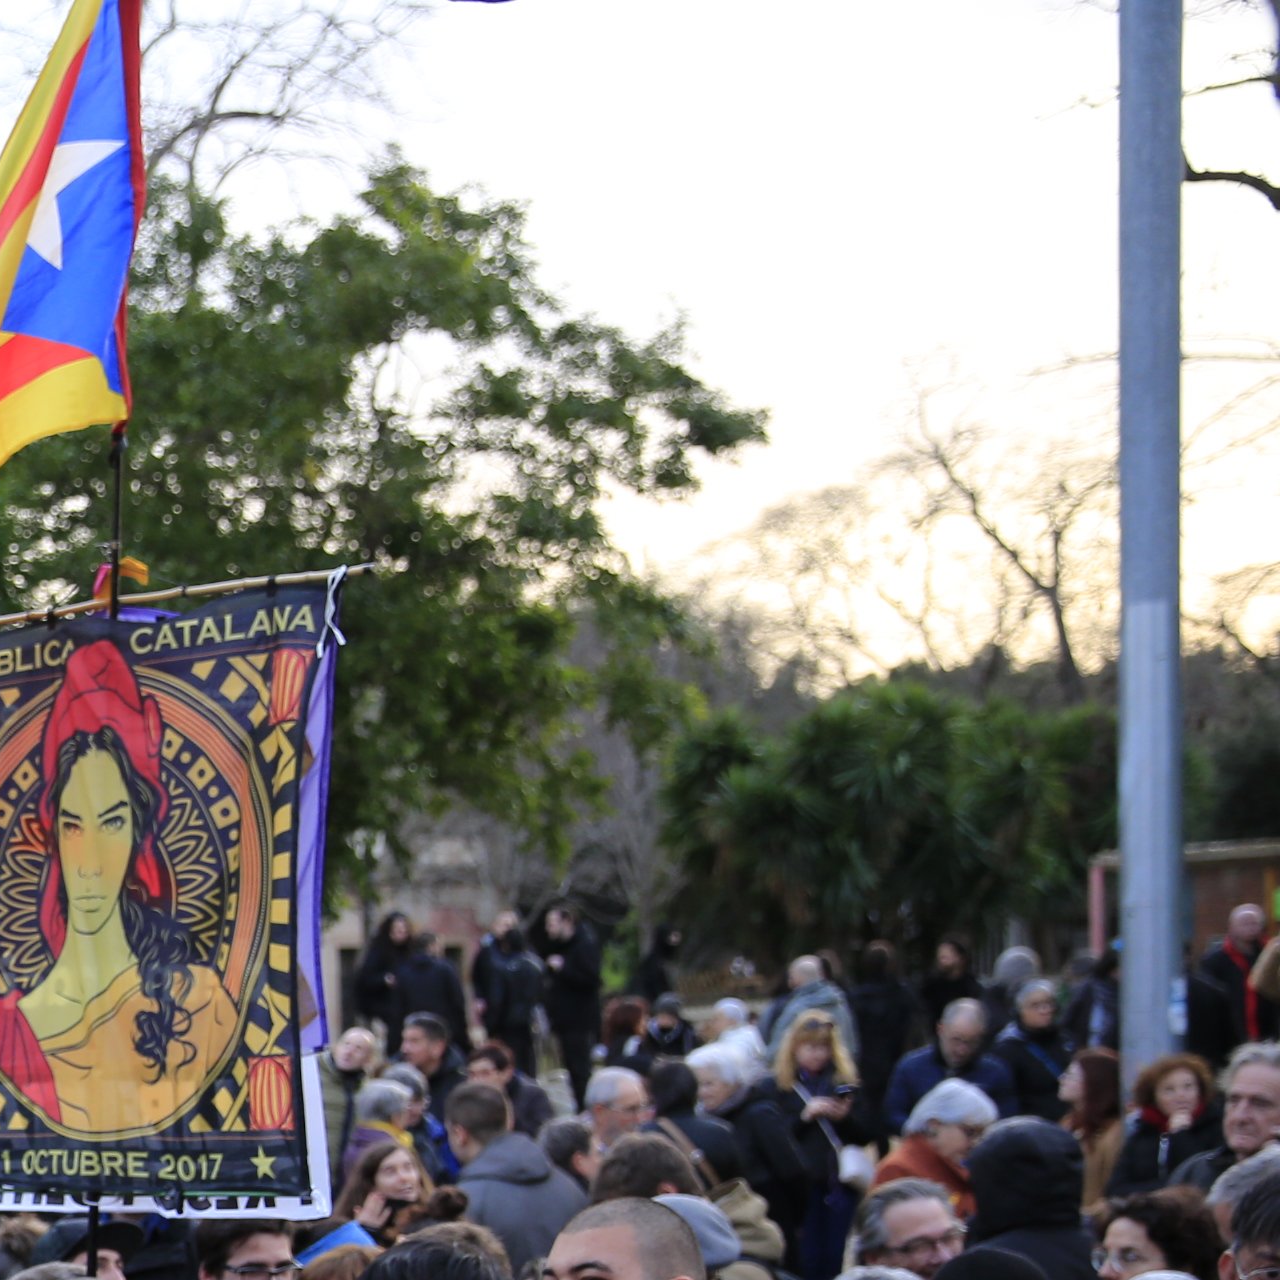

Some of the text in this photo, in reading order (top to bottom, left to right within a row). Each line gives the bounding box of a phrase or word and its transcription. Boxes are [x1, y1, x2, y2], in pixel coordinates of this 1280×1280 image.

[129, 604, 316, 655] CATALANA
[0, 1148, 224, 1182] 1 OCTUBRE 2017
